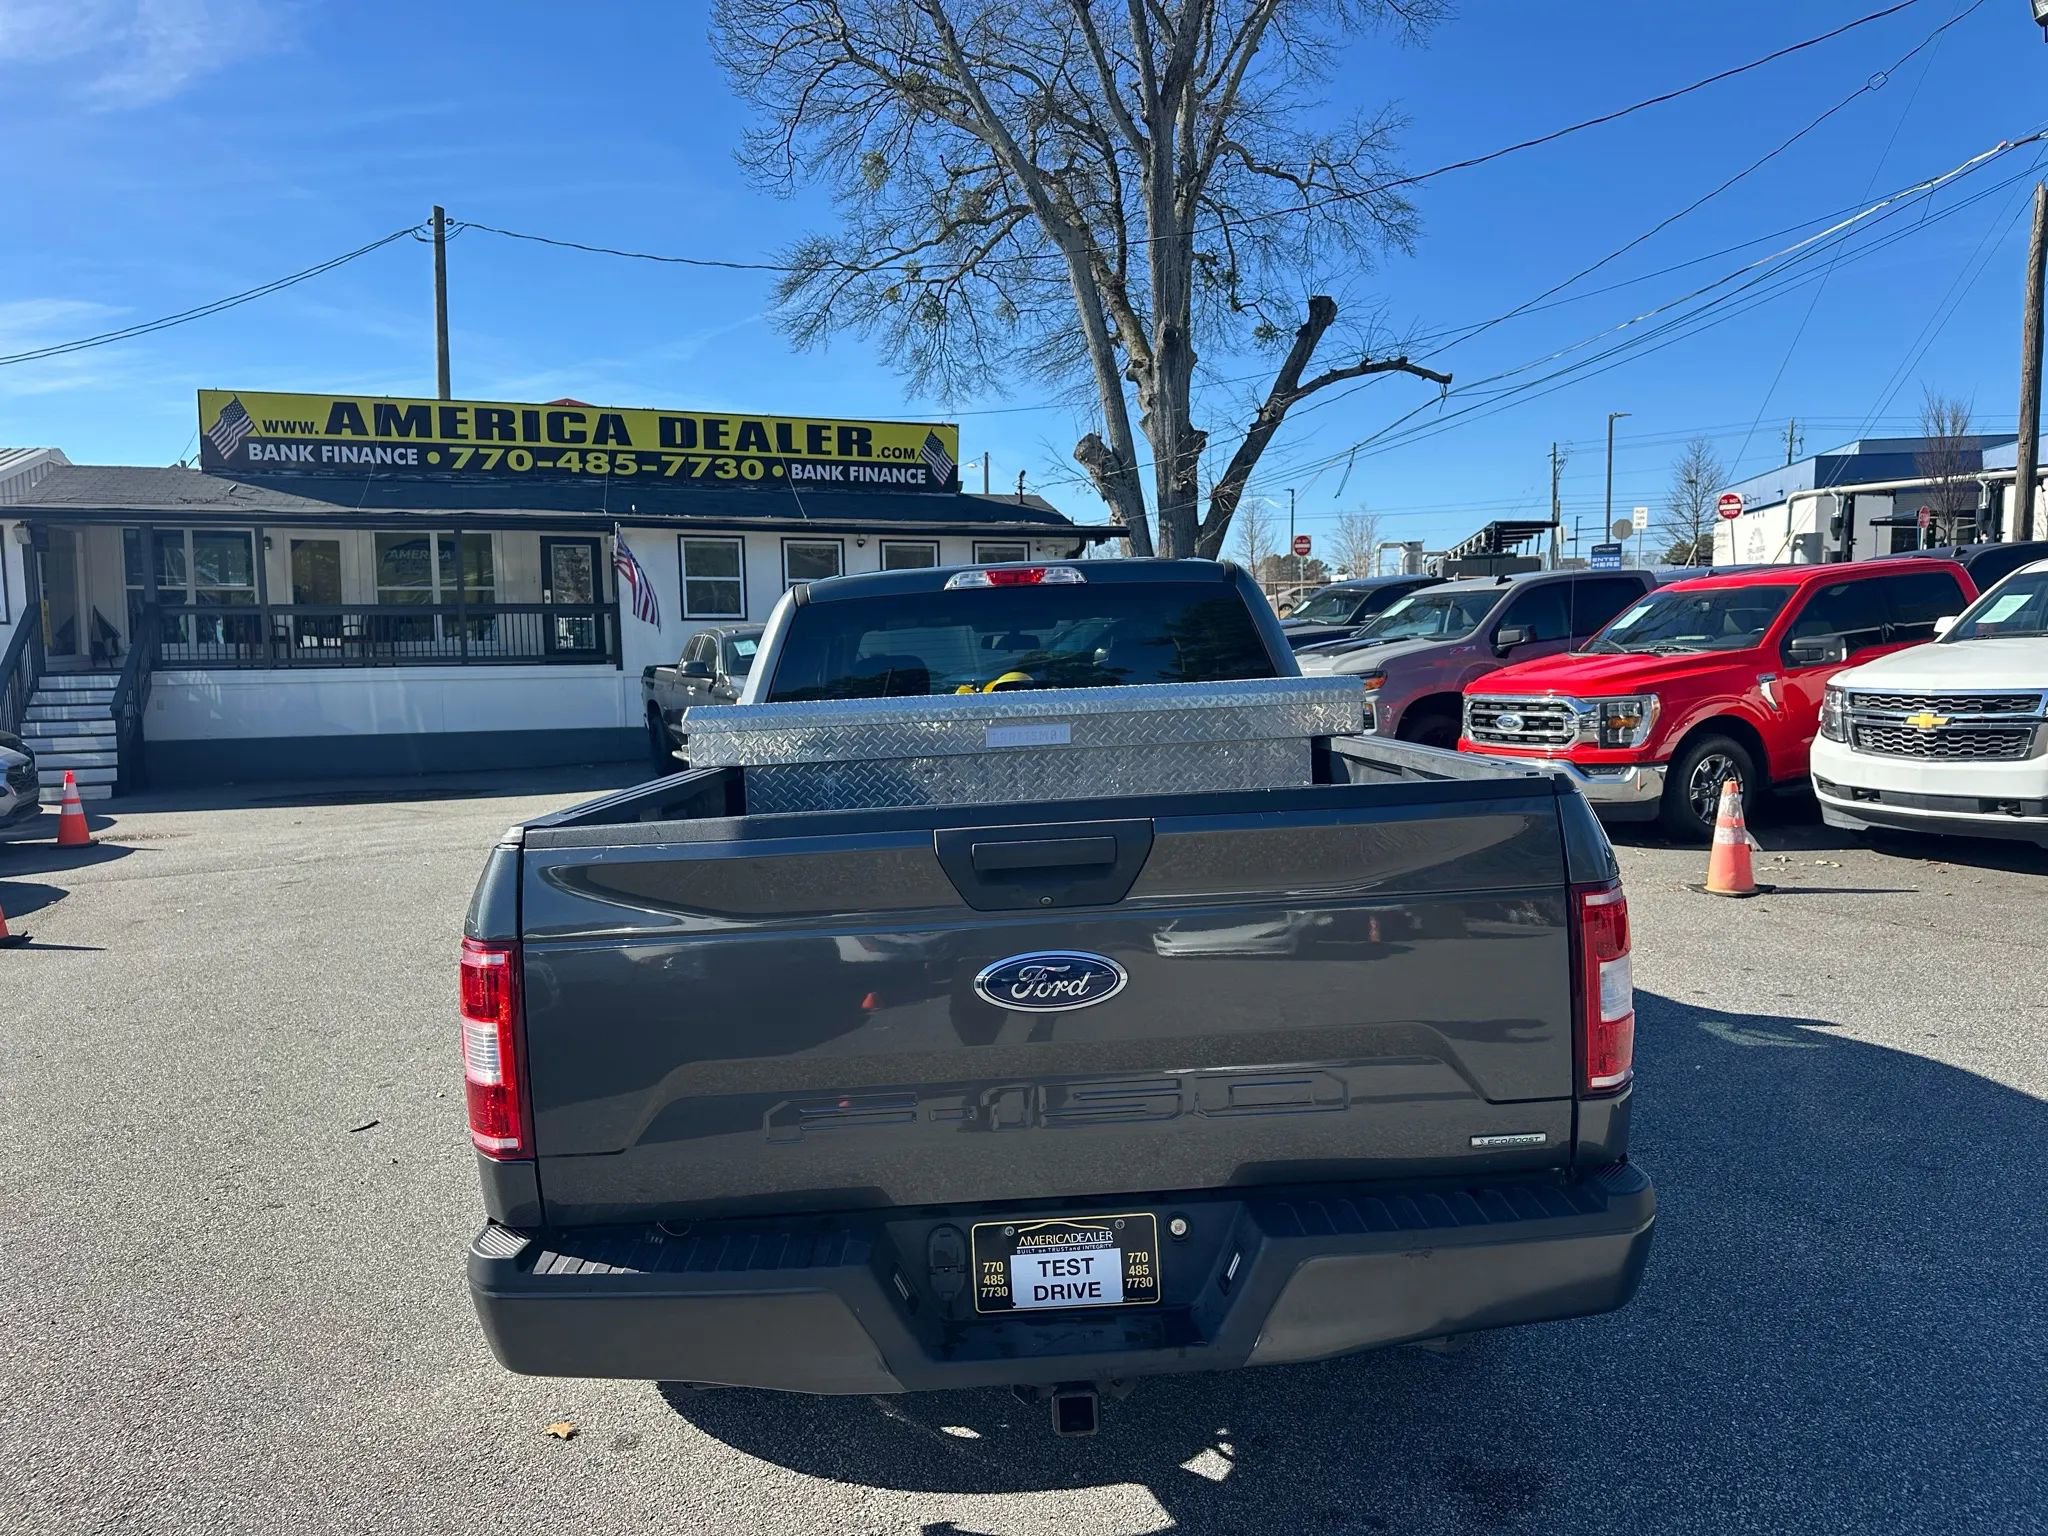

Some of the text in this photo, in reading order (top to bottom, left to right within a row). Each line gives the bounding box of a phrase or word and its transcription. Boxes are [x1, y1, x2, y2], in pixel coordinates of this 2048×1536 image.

[324, 401, 632, 446] AMERICA
[659, 416, 873, 457] DEALER
[248, 443, 926, 484] BANK FINANCE 770-485-7730 BANK FINANCE
[387, 549, 452, 560] AMERCA
[1011, 965, 1091, 999] Ford
[1019, 1231, 1113, 1246] AMERICADEALER
[1127, 1252, 1149, 1263] 770
[983, 1261, 1004, 1273] 770
[1037, 1257, 1095, 1278] TEST
[1128, 1264, 1150, 1276] 485
[983, 1274, 1005, 1285] 485
[1126, 1277, 1153, 1288] 7730
[981, 1287, 1008, 1298] 7730
[1033, 1281, 1102, 1301] DRIVE
